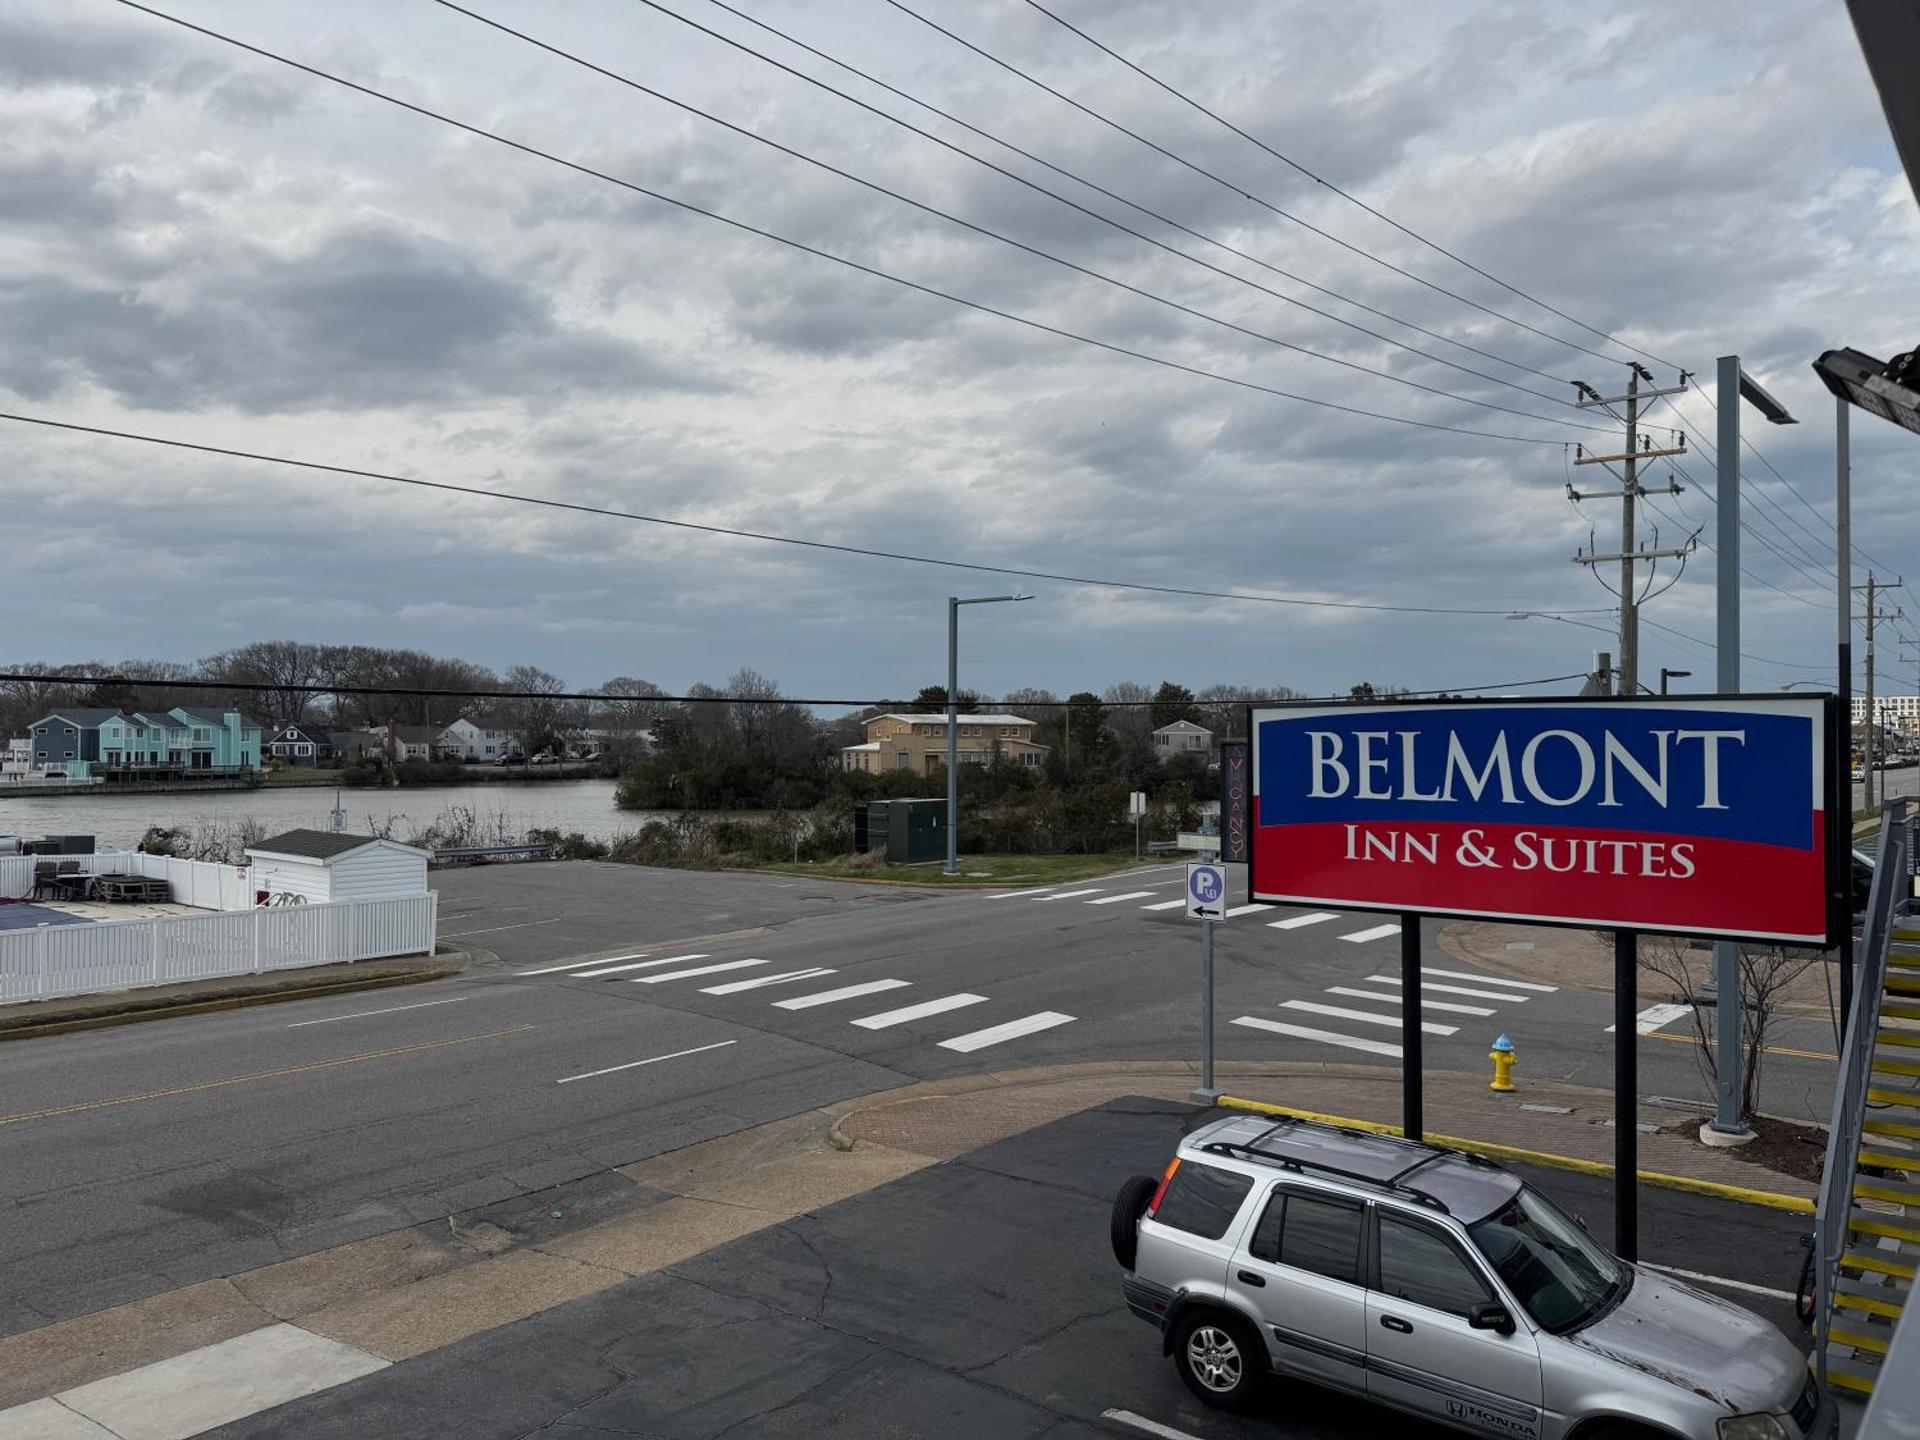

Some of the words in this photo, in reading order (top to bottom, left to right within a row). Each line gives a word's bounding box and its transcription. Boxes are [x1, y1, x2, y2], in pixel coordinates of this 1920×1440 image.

[1304, 729, 1746, 810] BELMONT
[1229, 758, 1244, 858] VCANCY
[1343, 824, 1441, 865] INN
[1455, 829, 1504, 869] &
[1512, 831, 1696, 879] SUITES
[1196, 872, 1214, 895] P
[1468, 1407, 1537, 1437] HONDA
